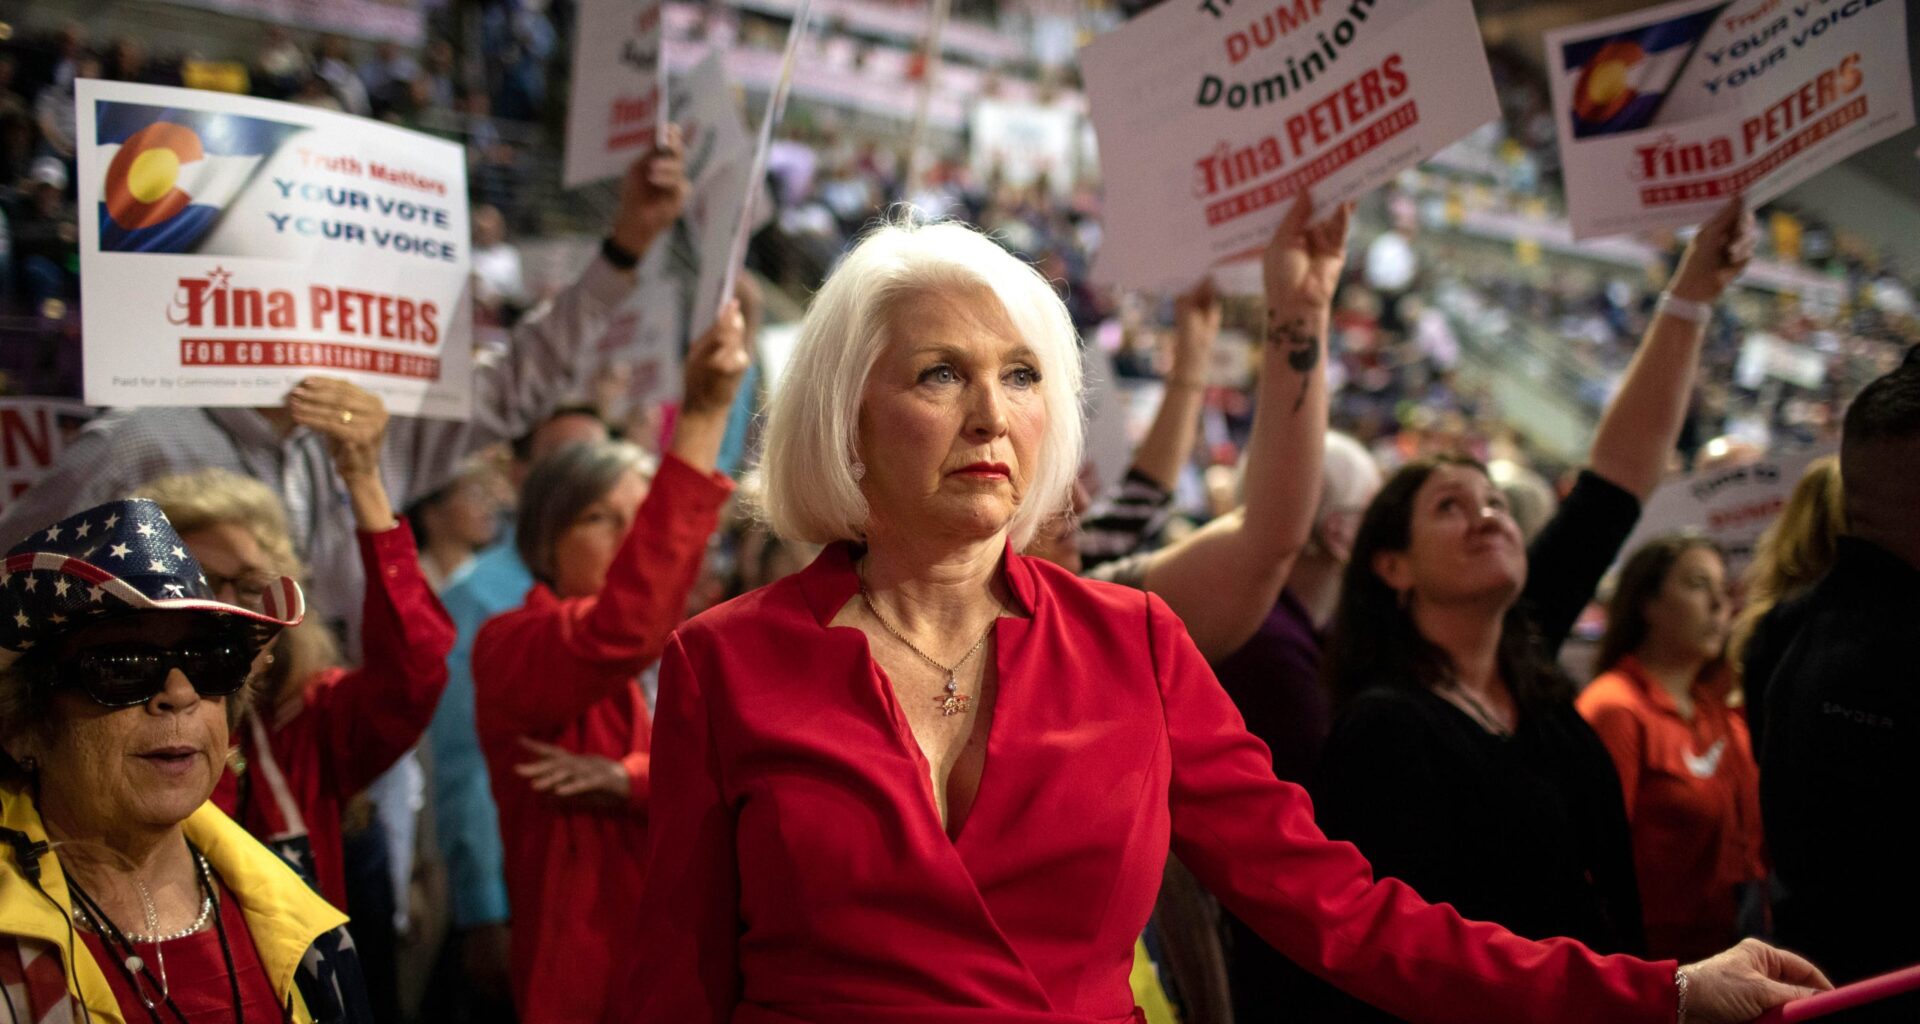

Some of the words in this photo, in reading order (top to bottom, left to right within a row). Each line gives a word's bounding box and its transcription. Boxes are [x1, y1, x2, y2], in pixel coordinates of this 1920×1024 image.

[1197, 0, 1377, 109] Dominion
[1707, 15, 1788, 64] YOUR
[1704, 47, 1786, 94] YOUR
[1196, 136, 1283, 194] Tina
[1285, 53, 1409, 156] PETERS
[1635, 136, 1734, 178] Tina
[1742, 53, 1863, 154] PETERS
[298, 149, 363, 175] Truth
[368, 161, 447, 196] Matters
[274, 177, 369, 211] YOUR
[375, 195, 449, 229] VOTE
[268, 212, 365, 244] YOUR
[372, 228, 457, 262] VOICE
[173, 271, 296, 328] Tina
[310, 284, 439, 344] PETERS
[184, 341, 225, 363] FOR
[236, 342, 263, 364] CO
[274, 342, 371, 370] SECRETARY
[1823, 700, 1893, 725] SPYDER
